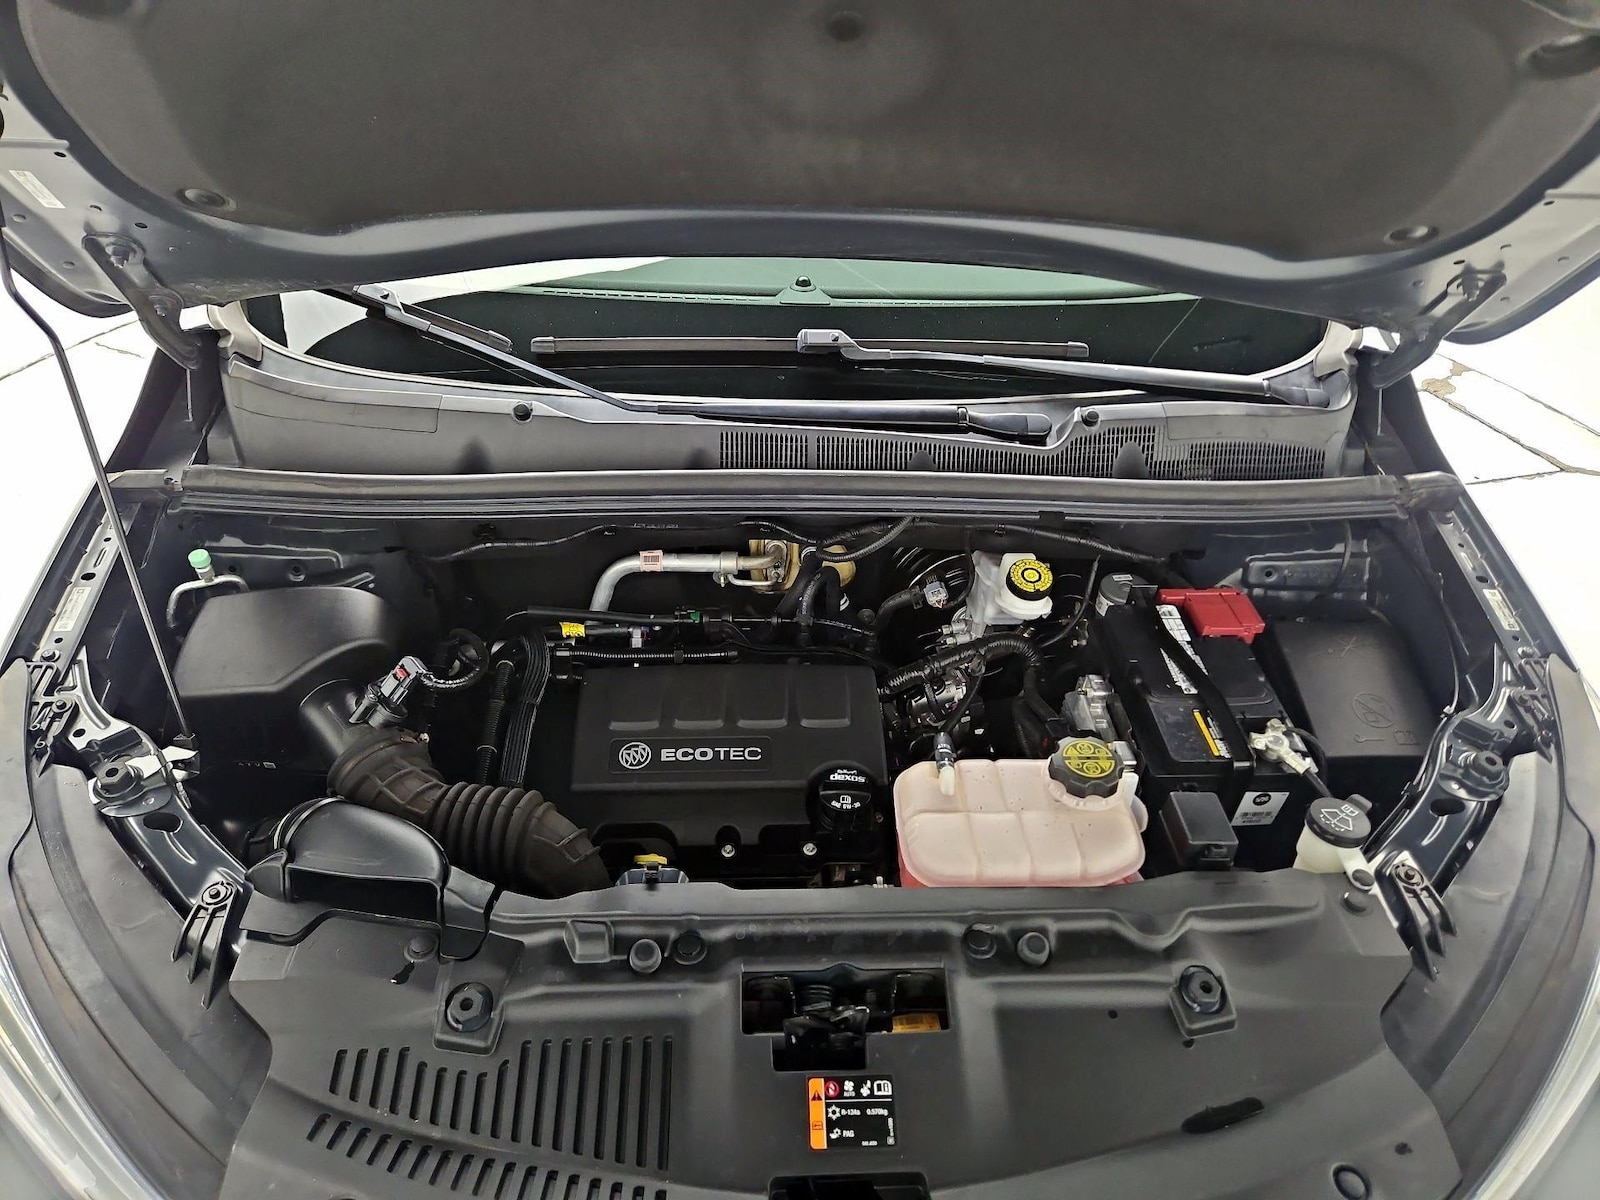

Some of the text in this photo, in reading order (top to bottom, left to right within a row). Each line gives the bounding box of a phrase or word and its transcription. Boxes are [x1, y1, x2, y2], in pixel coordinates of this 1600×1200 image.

[660, 747, 762, 762] ECOTEC
[830, 773, 866, 782] dexos
[842, 1130, 855, 1138] PAG
